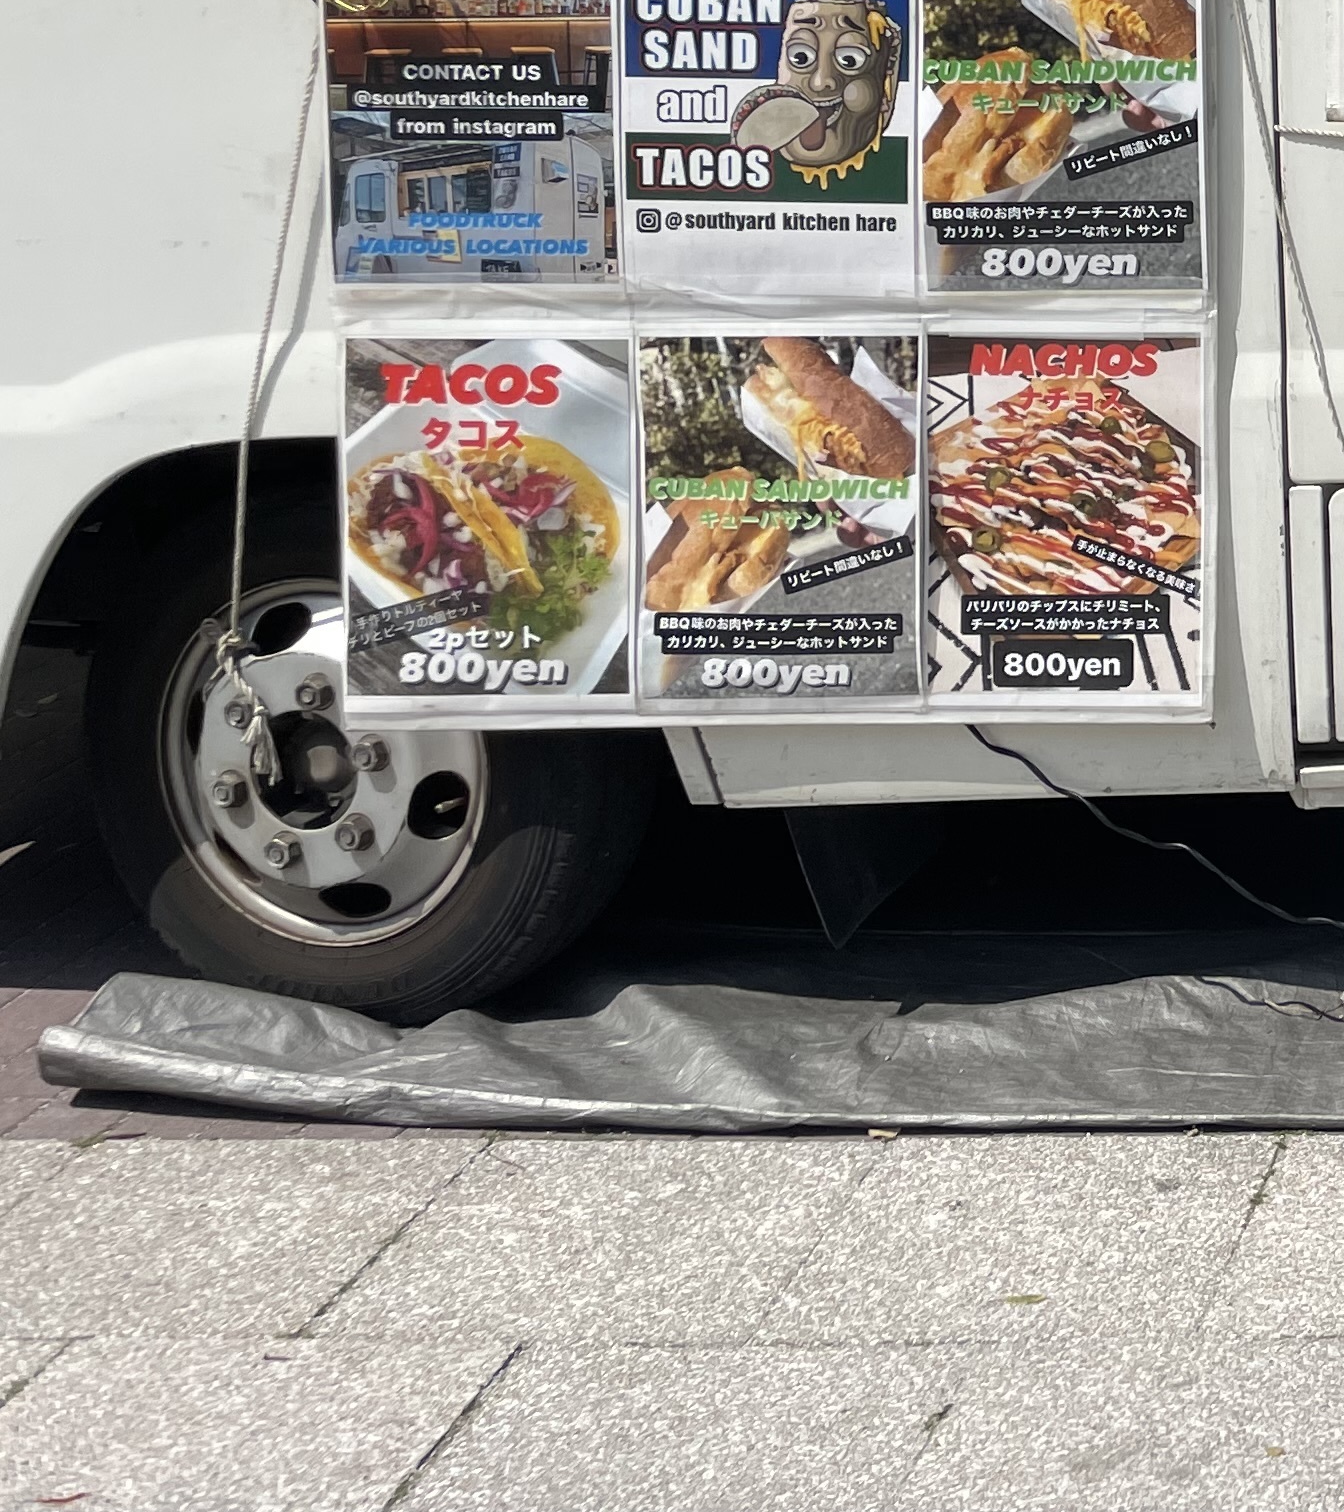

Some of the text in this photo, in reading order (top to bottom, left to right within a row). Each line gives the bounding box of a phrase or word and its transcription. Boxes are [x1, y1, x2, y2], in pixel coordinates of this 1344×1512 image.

[643, 29, 759, 72] SAND
[402, 64, 542, 81] CONTACT US
[923, 58, 1197, 83] CUBAN SANDWICH
[352, 90, 590, 109] @southyardkitchenhare
[657, 85, 727, 123] and
[971, 91, 1128, 115] キューバサンド
[397, 117, 557, 138] from instagram
[635, 147, 771, 189] TACOS
[408, 212, 544, 229] FOODTRUCK
[782, 213, 850, 231] kitchen
[856, 214, 897, 231] hare
[357, 238, 589, 256] VARIOUS LOCATIONS
[981, 246, 1140, 285] 800yen
[969, 343, 1160, 379] NACHOS
[380, 363, 563, 408] TACOS
[1017, 388, 1126, 413] ナチョス
[420, 416, 525, 451] タコス
[649, 477, 910, 502] CUBAN SANDWICH
[700, 509, 843, 531] キューバサンド
[970, 616, 1160, 632] チーズソースがかかったナチョス
[429, 624, 541, 653] 2pセット
[400, 649, 568, 691] 800yen
[701, 657, 852, 695] 800yen
[1003, 652, 1122, 680] 800yen
